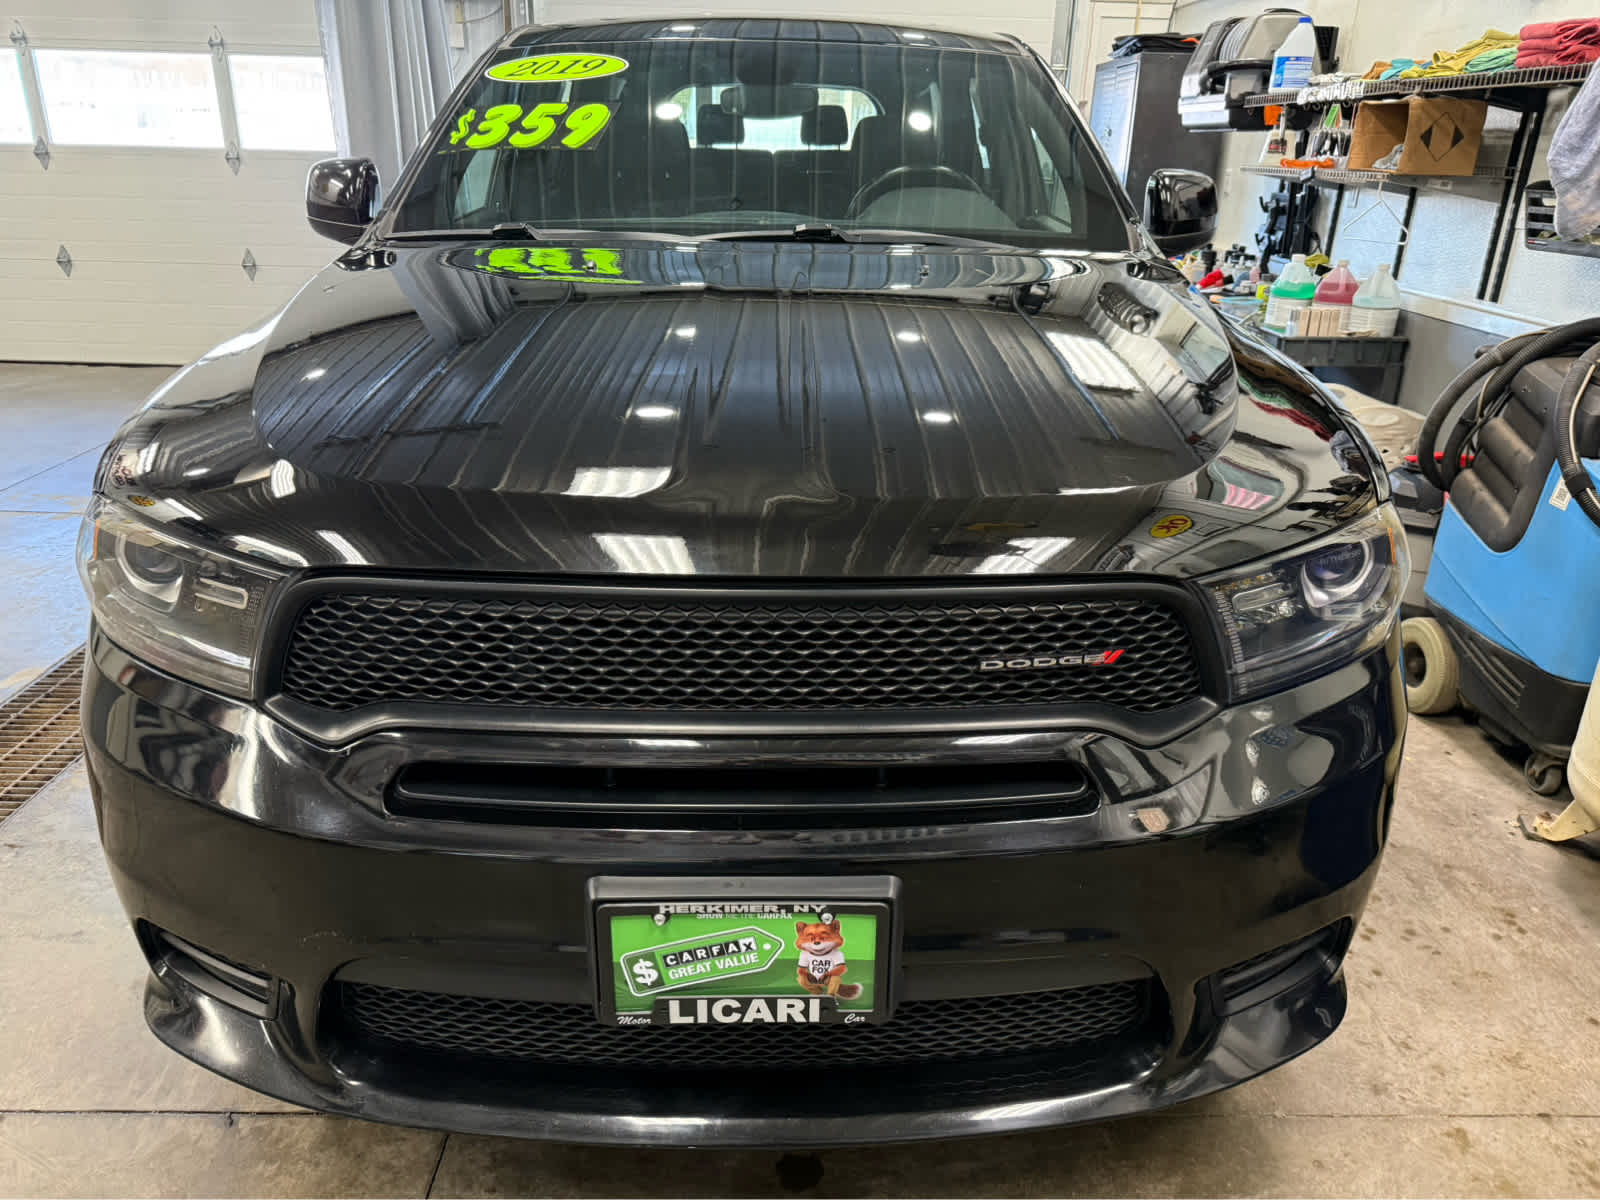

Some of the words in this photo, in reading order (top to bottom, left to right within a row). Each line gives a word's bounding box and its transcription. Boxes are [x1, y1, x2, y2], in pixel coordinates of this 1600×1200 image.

[504, 58, 608, 77] 2019
[450, 103, 611, 149] $359
[980, 654, 1105, 672] DODGE
[659, 904, 786, 914] HERKIMER,
[793, 904, 827, 913] NY
[665, 939, 755, 966] CARFAX
[668, 962, 712, 980] GREAT
[716, 953, 760, 969] VALUE
[616, 1016, 652, 1025] Motor
[668, 998, 820, 1024] LICARI
[844, 1013, 866, 1024] Car
